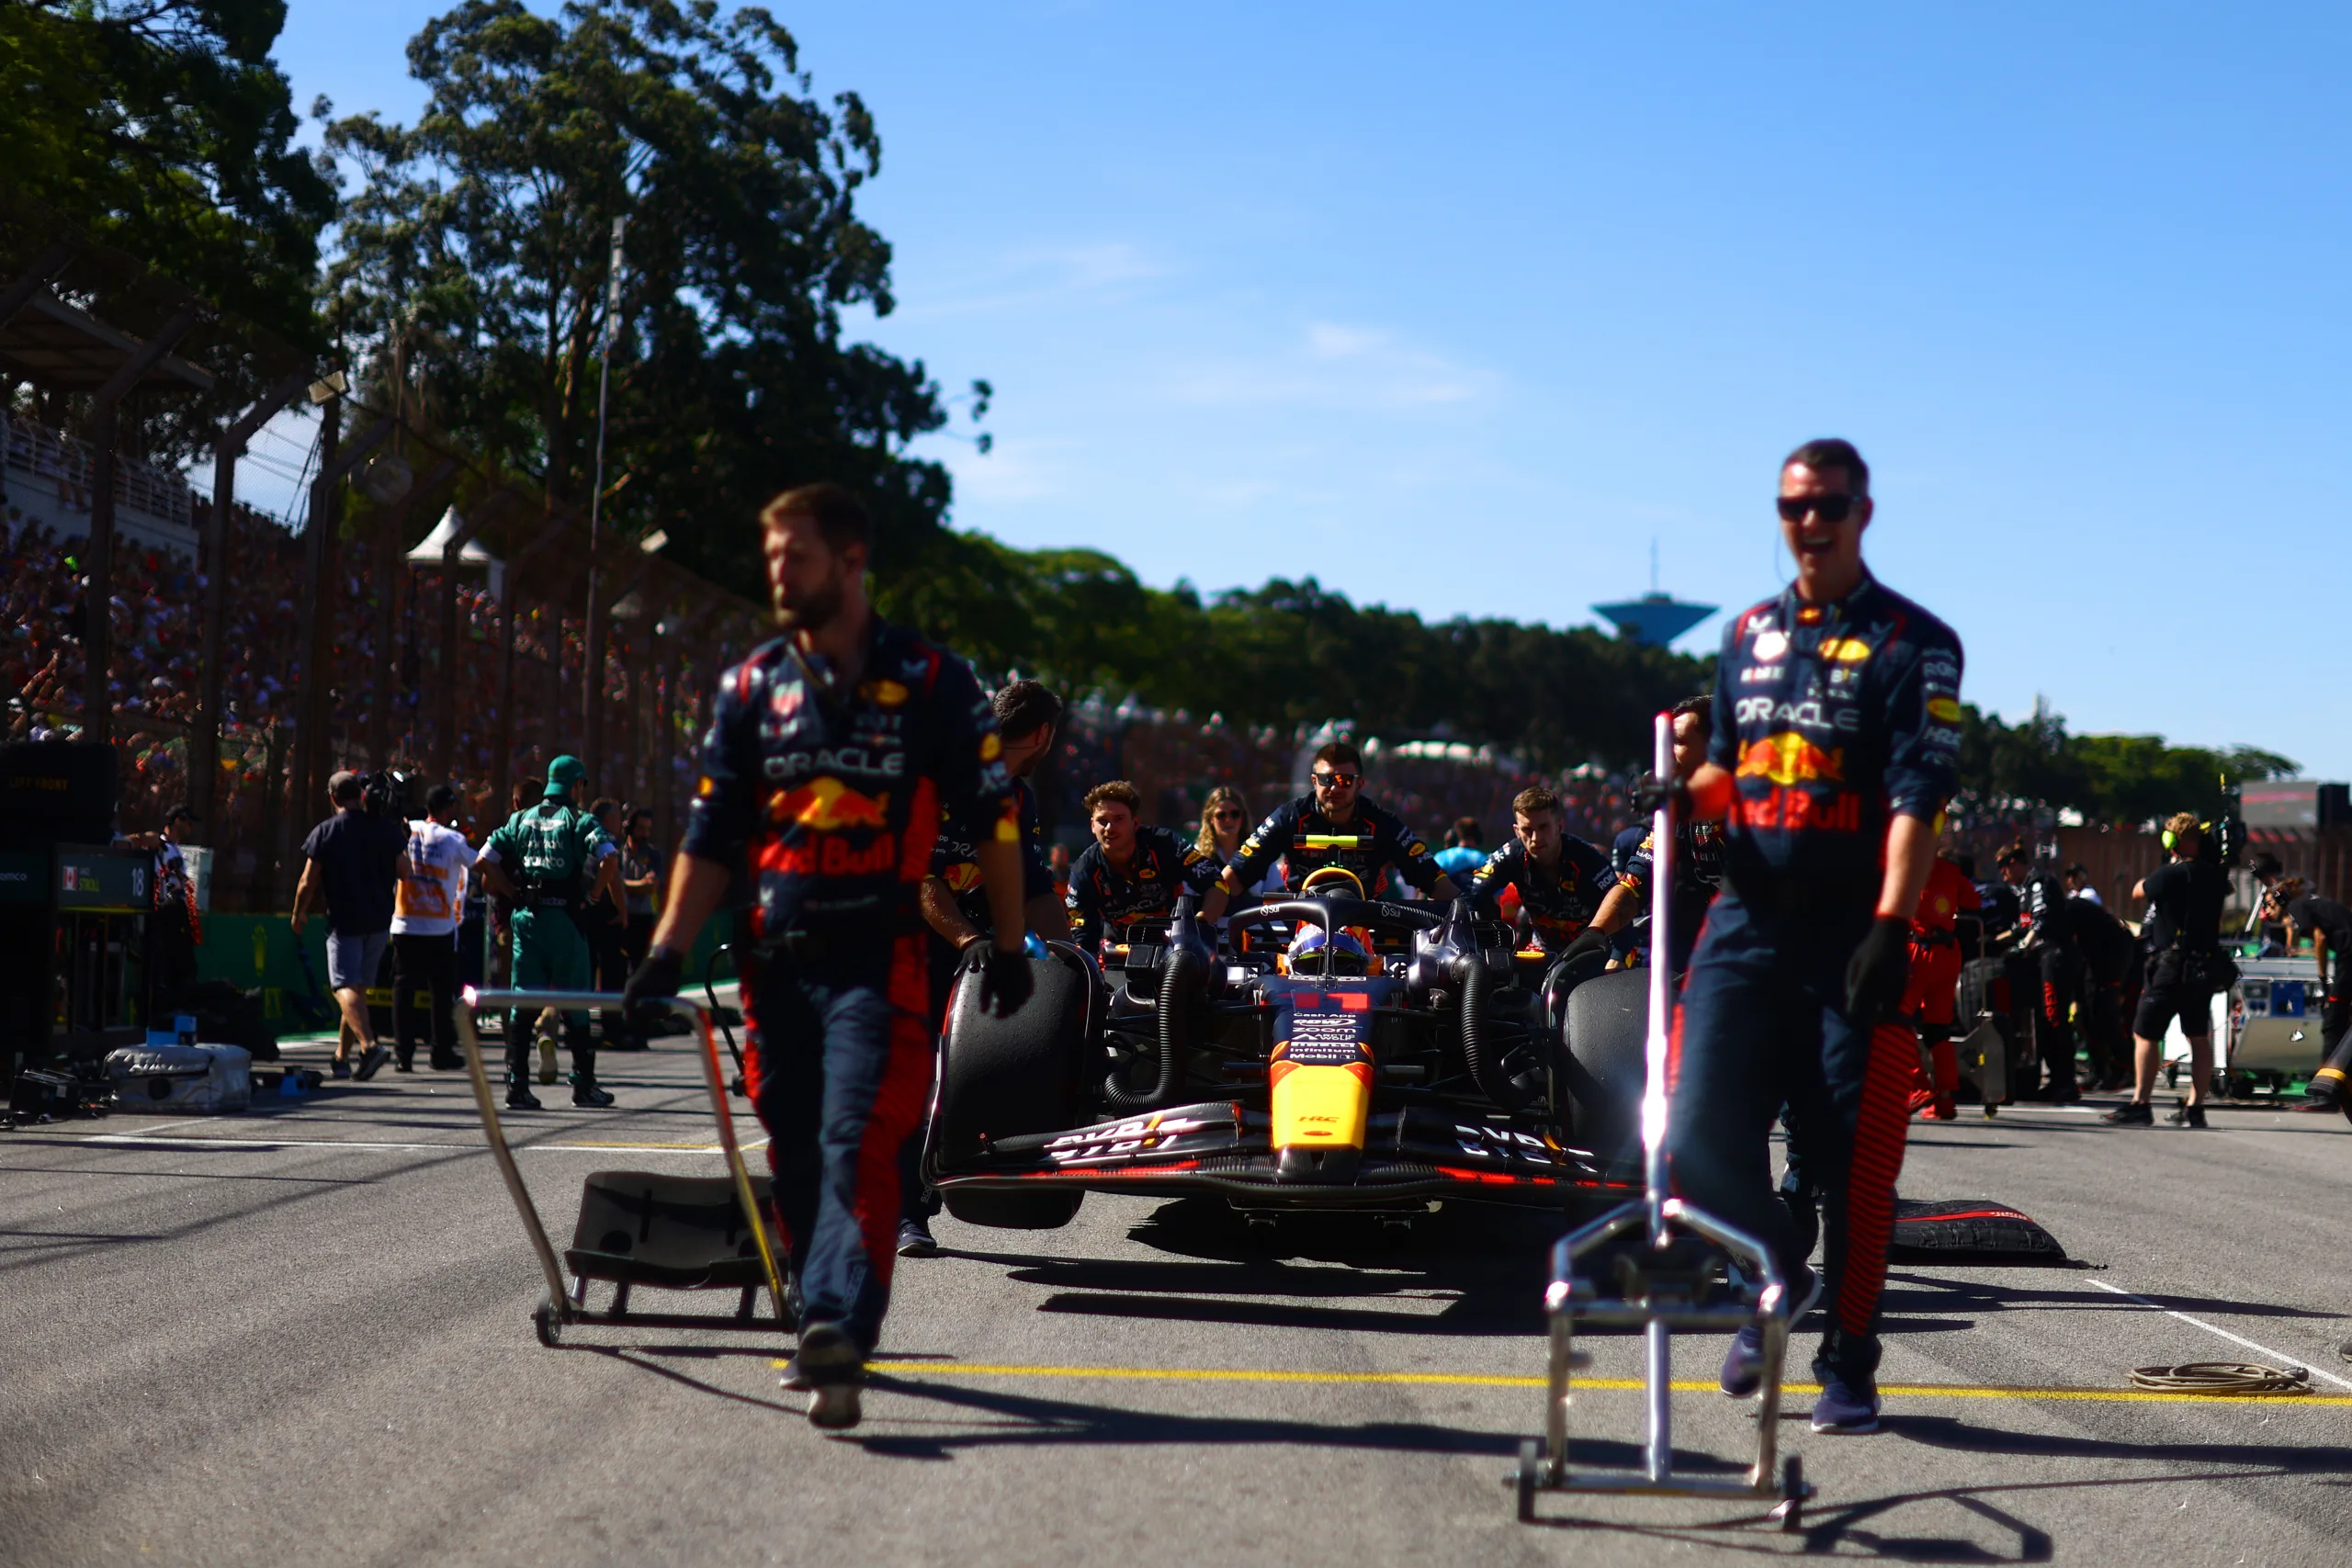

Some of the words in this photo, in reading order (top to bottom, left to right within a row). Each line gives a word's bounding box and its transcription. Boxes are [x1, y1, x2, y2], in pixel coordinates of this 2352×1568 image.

[1736, 696, 1860, 731] ORACLE
[762, 746, 908, 779] ORACLE
[130, 867, 144, 897] 18
[1298, 1115, 1340, 1123] HRC
